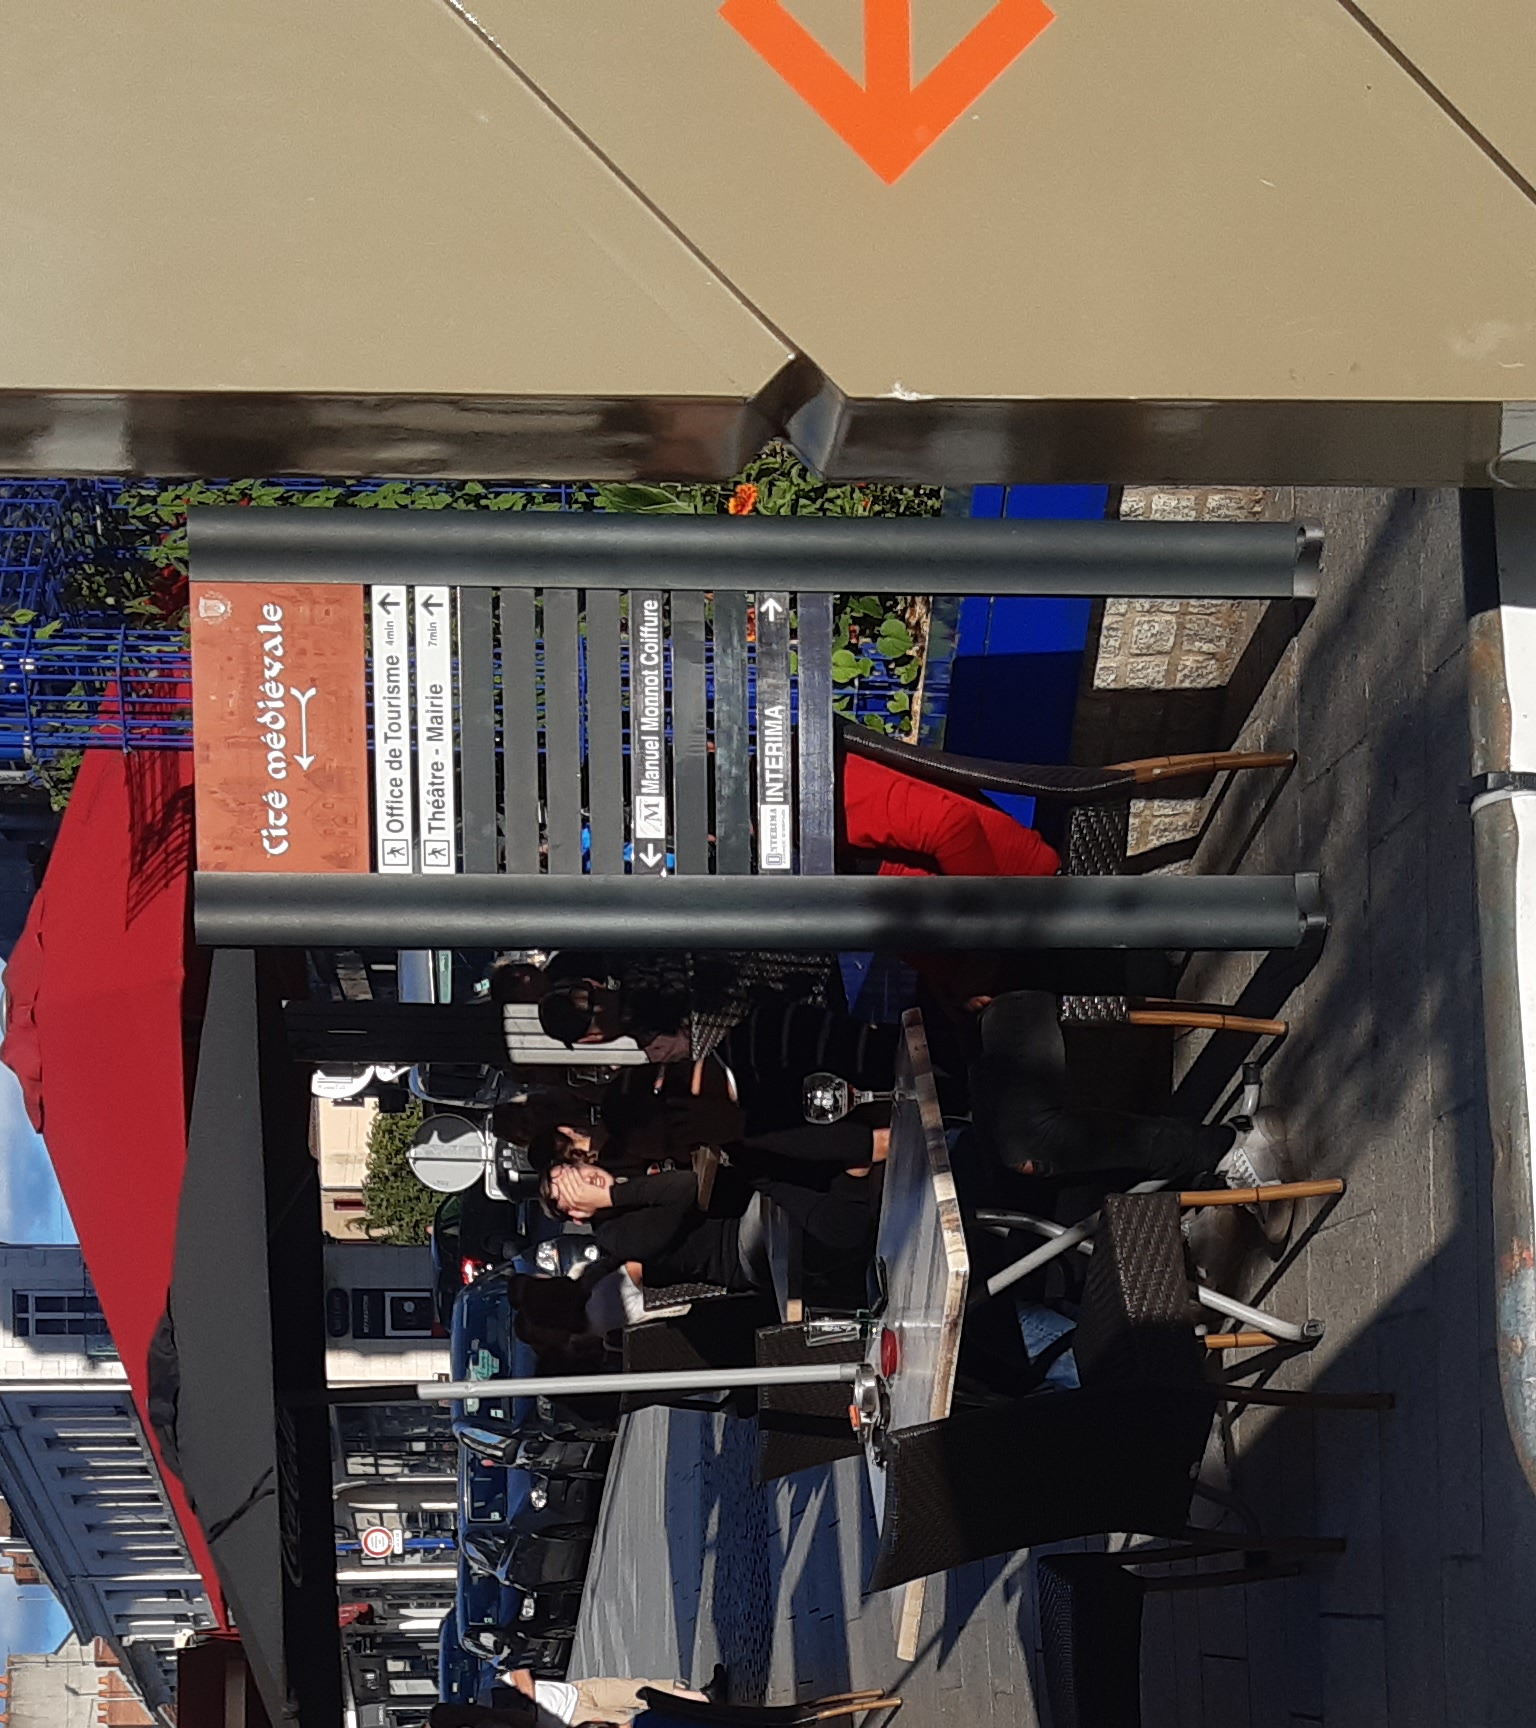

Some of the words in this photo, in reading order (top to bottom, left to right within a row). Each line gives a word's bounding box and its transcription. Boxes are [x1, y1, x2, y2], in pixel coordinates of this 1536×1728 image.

[384, 621, 395, 646] 4min
[427, 622, 438, 647] 7min
[639, 600, 658, 665] Coiffure
[256, 603, 288, 780] médiévale
[383, 655, 402, 744] Tourisme
[425, 684, 444, 742] Mairie
[640, 670, 659, 731] Monnot
[384, 748, 402, 771] de
[640, 736, 660, 794] Manuel
[764, 705, 784, 802] INTERIMA
[260, 789, 289, 855] Cité
[385, 777, 404, 834] Office
[426, 761, 446, 835] Théâtre
